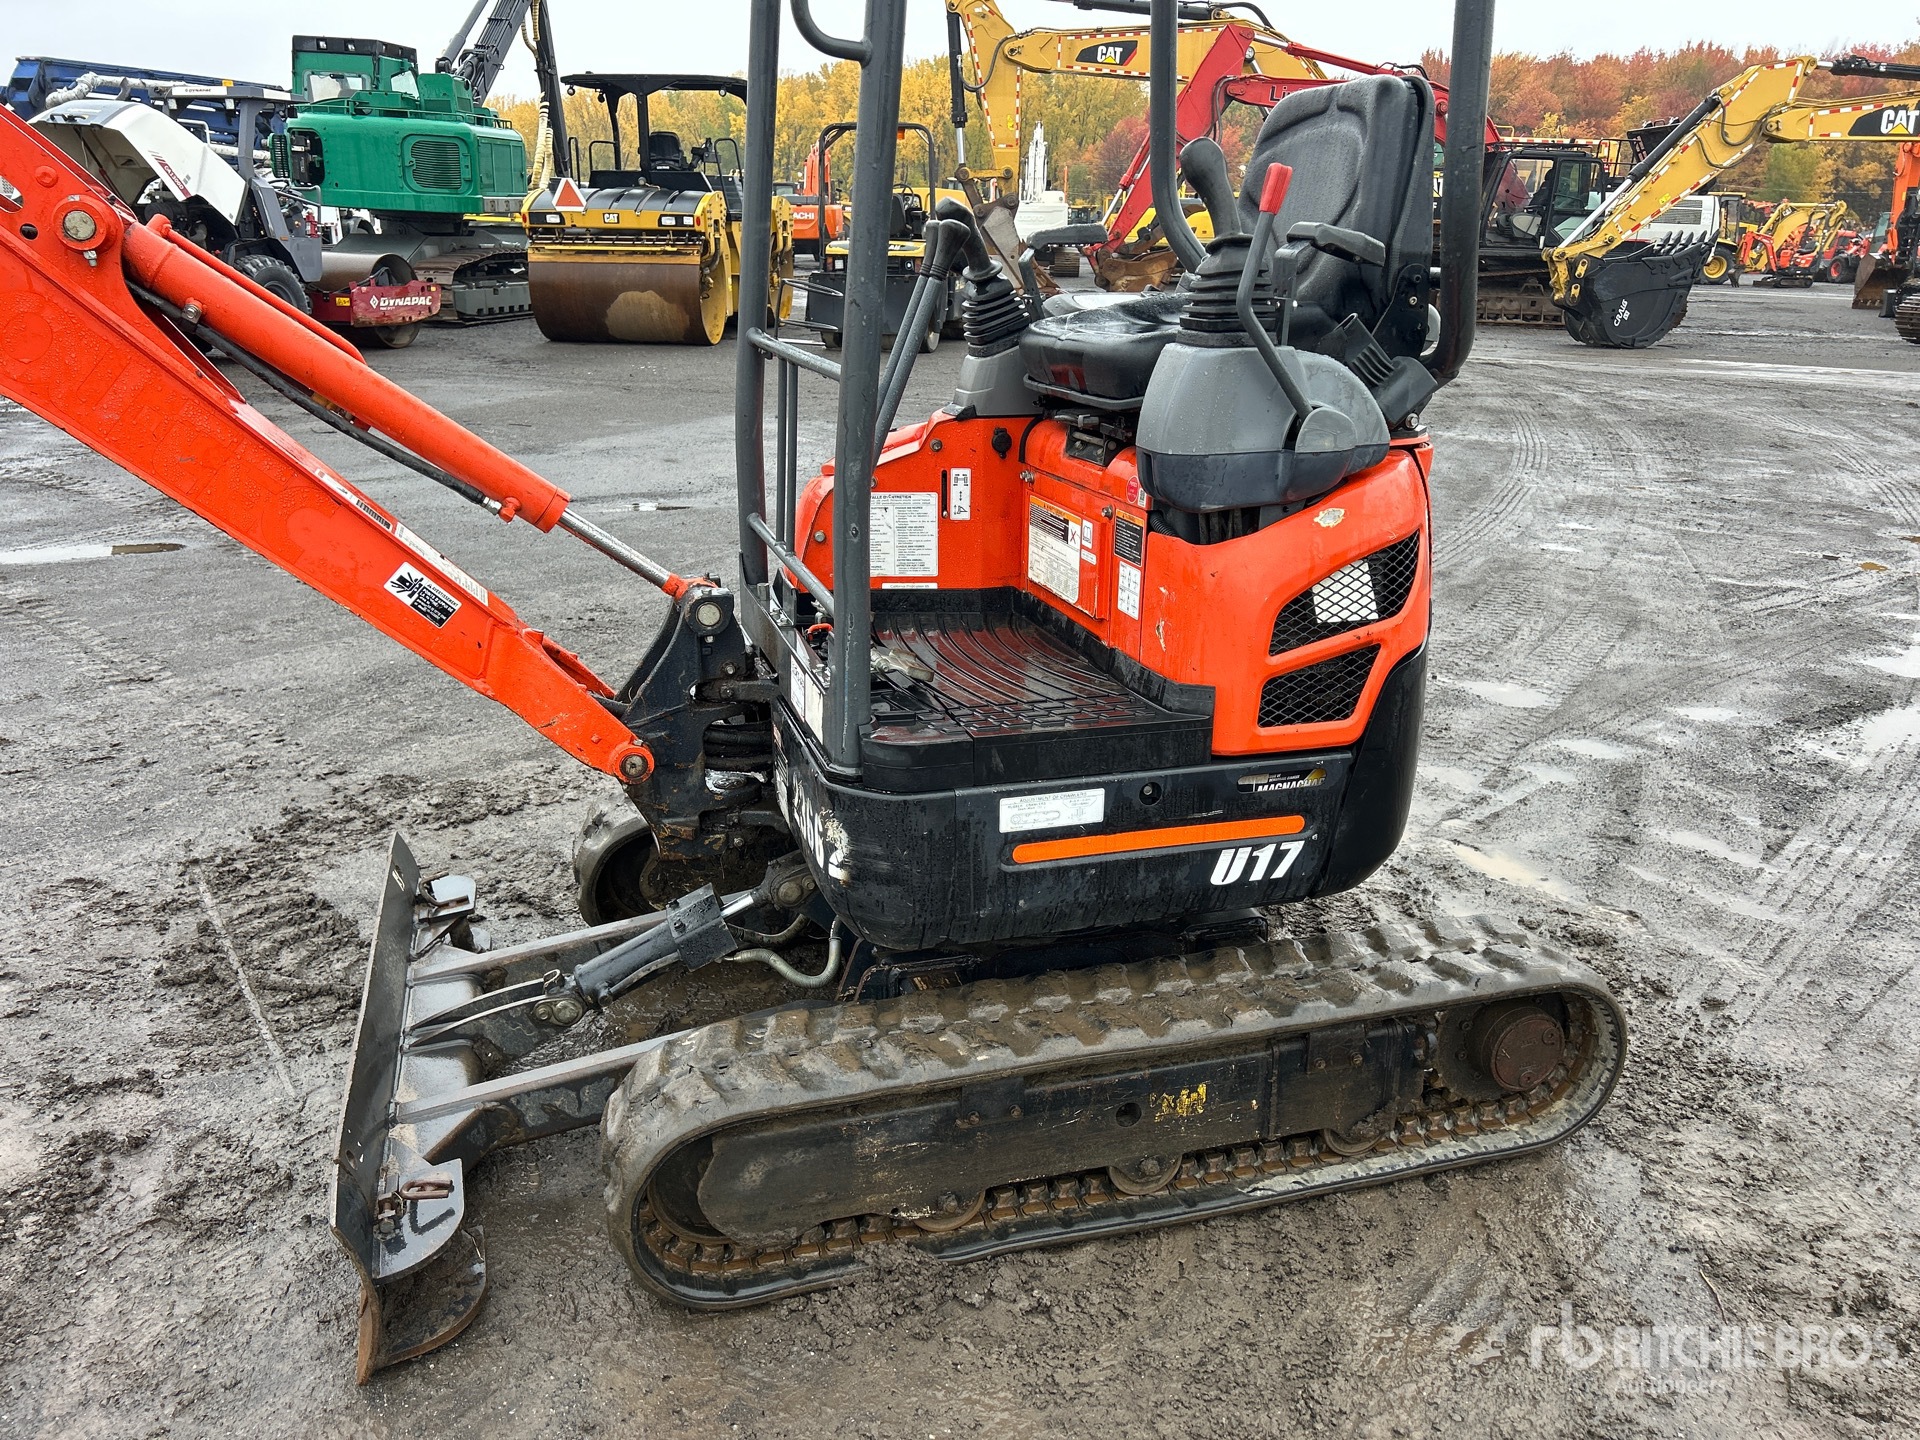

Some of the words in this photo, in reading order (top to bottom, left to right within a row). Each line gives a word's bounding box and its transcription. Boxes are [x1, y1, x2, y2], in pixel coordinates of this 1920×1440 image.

[1097, 45, 1123, 64] CAT
[1880, 109, 1920, 135] CAT
[604, 213, 619, 224] CAT
[792, 212, 814, 220] ACHI
[379, 296, 433, 307] DYNAPAC
[1210, 841, 1305, 886] U17
